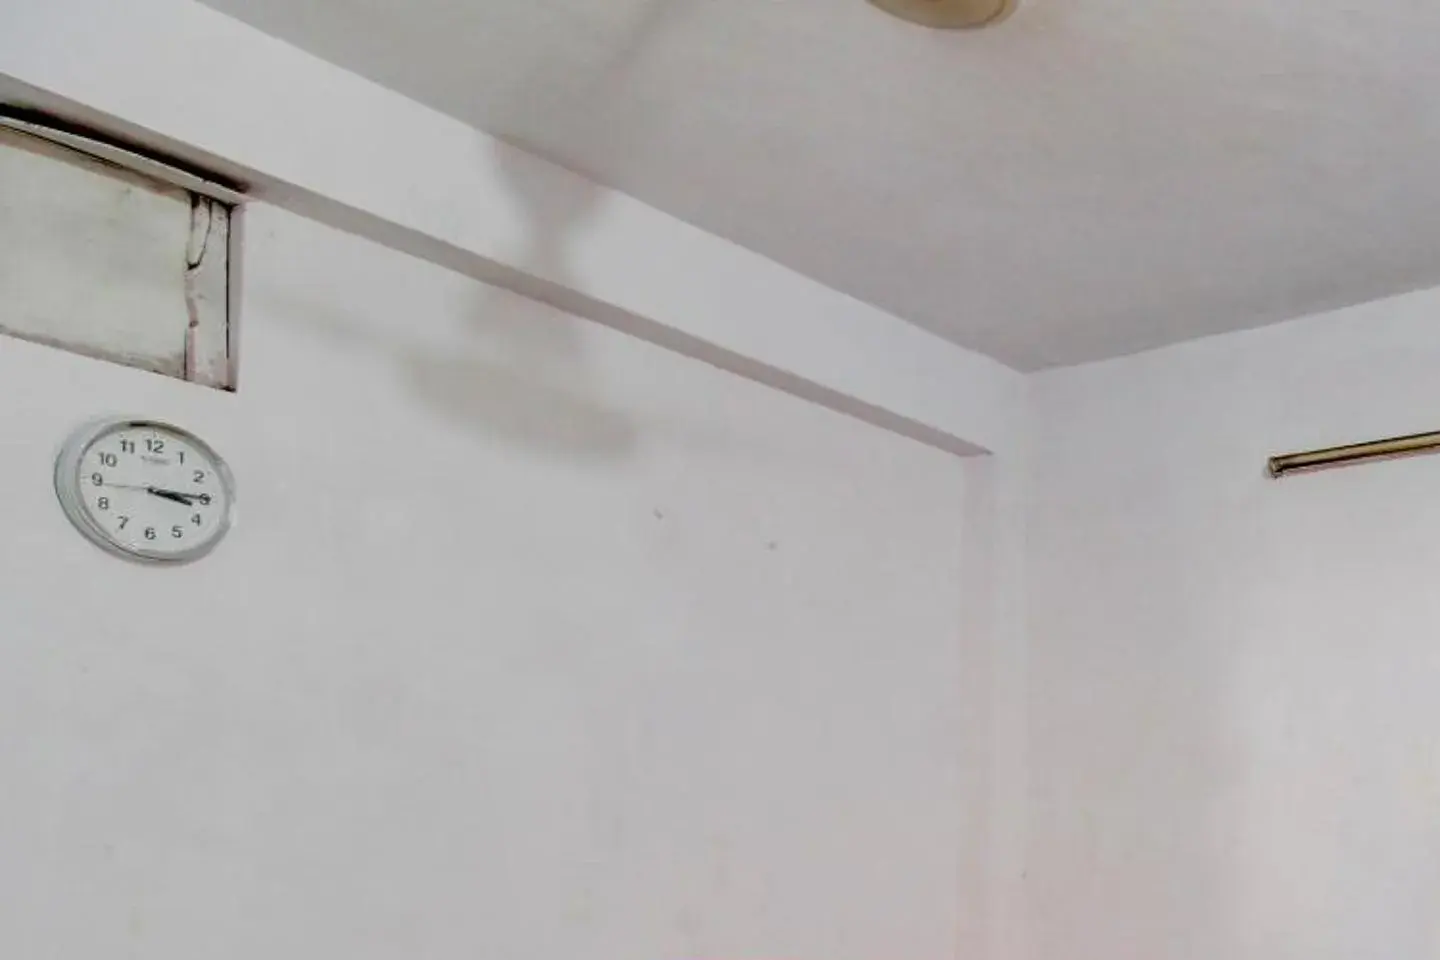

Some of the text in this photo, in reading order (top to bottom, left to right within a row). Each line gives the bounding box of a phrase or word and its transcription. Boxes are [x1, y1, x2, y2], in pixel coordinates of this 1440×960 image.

[121, 440, 135, 454] 11
[145, 440, 164, 453] 12
[99, 453, 117, 467] 10
[178, 452, 184, 465] 1
[92, 473, 103, 486] 9
[193, 470, 204, 483] 2
[98, 497, 109, 510] 8
[200, 493, 211, 505] 3
[118, 516, 129, 529] 7
[191, 513, 201, 527] 4
[145, 528, 156, 540] 6
[172, 527, 183, 539] 5
